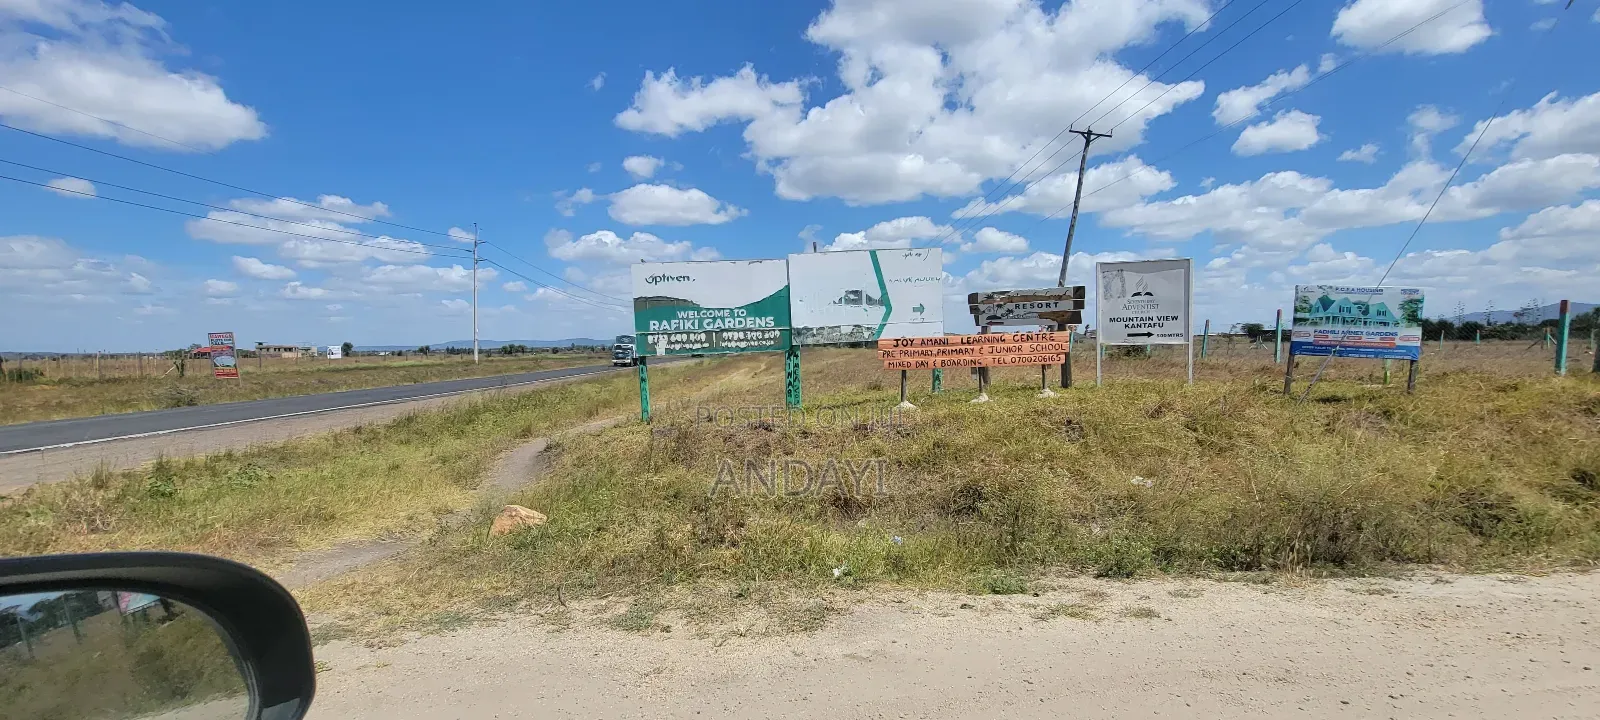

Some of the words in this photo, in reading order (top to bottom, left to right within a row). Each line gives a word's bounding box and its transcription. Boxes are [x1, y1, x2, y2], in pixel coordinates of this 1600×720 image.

[1014, 301, 1059, 310] RESORT
[677, 309, 731, 318] WELCOME
[733, 308, 747, 317] TO
[650, 319, 699, 331] RAFIKI
[703, 316, 775, 328] GARDENS
[893, 338, 915, 347] JOY
[920, 337, 949, 346] AMANI
[961, 335, 1006, 345] LEARNING
[1012, 332, 1055, 342] CENTRE
[988, 345, 1023, 354] JUNIOR
[1029, 343, 1066, 352] SCHOOL
[941, 358, 982, 368] BOARDING
